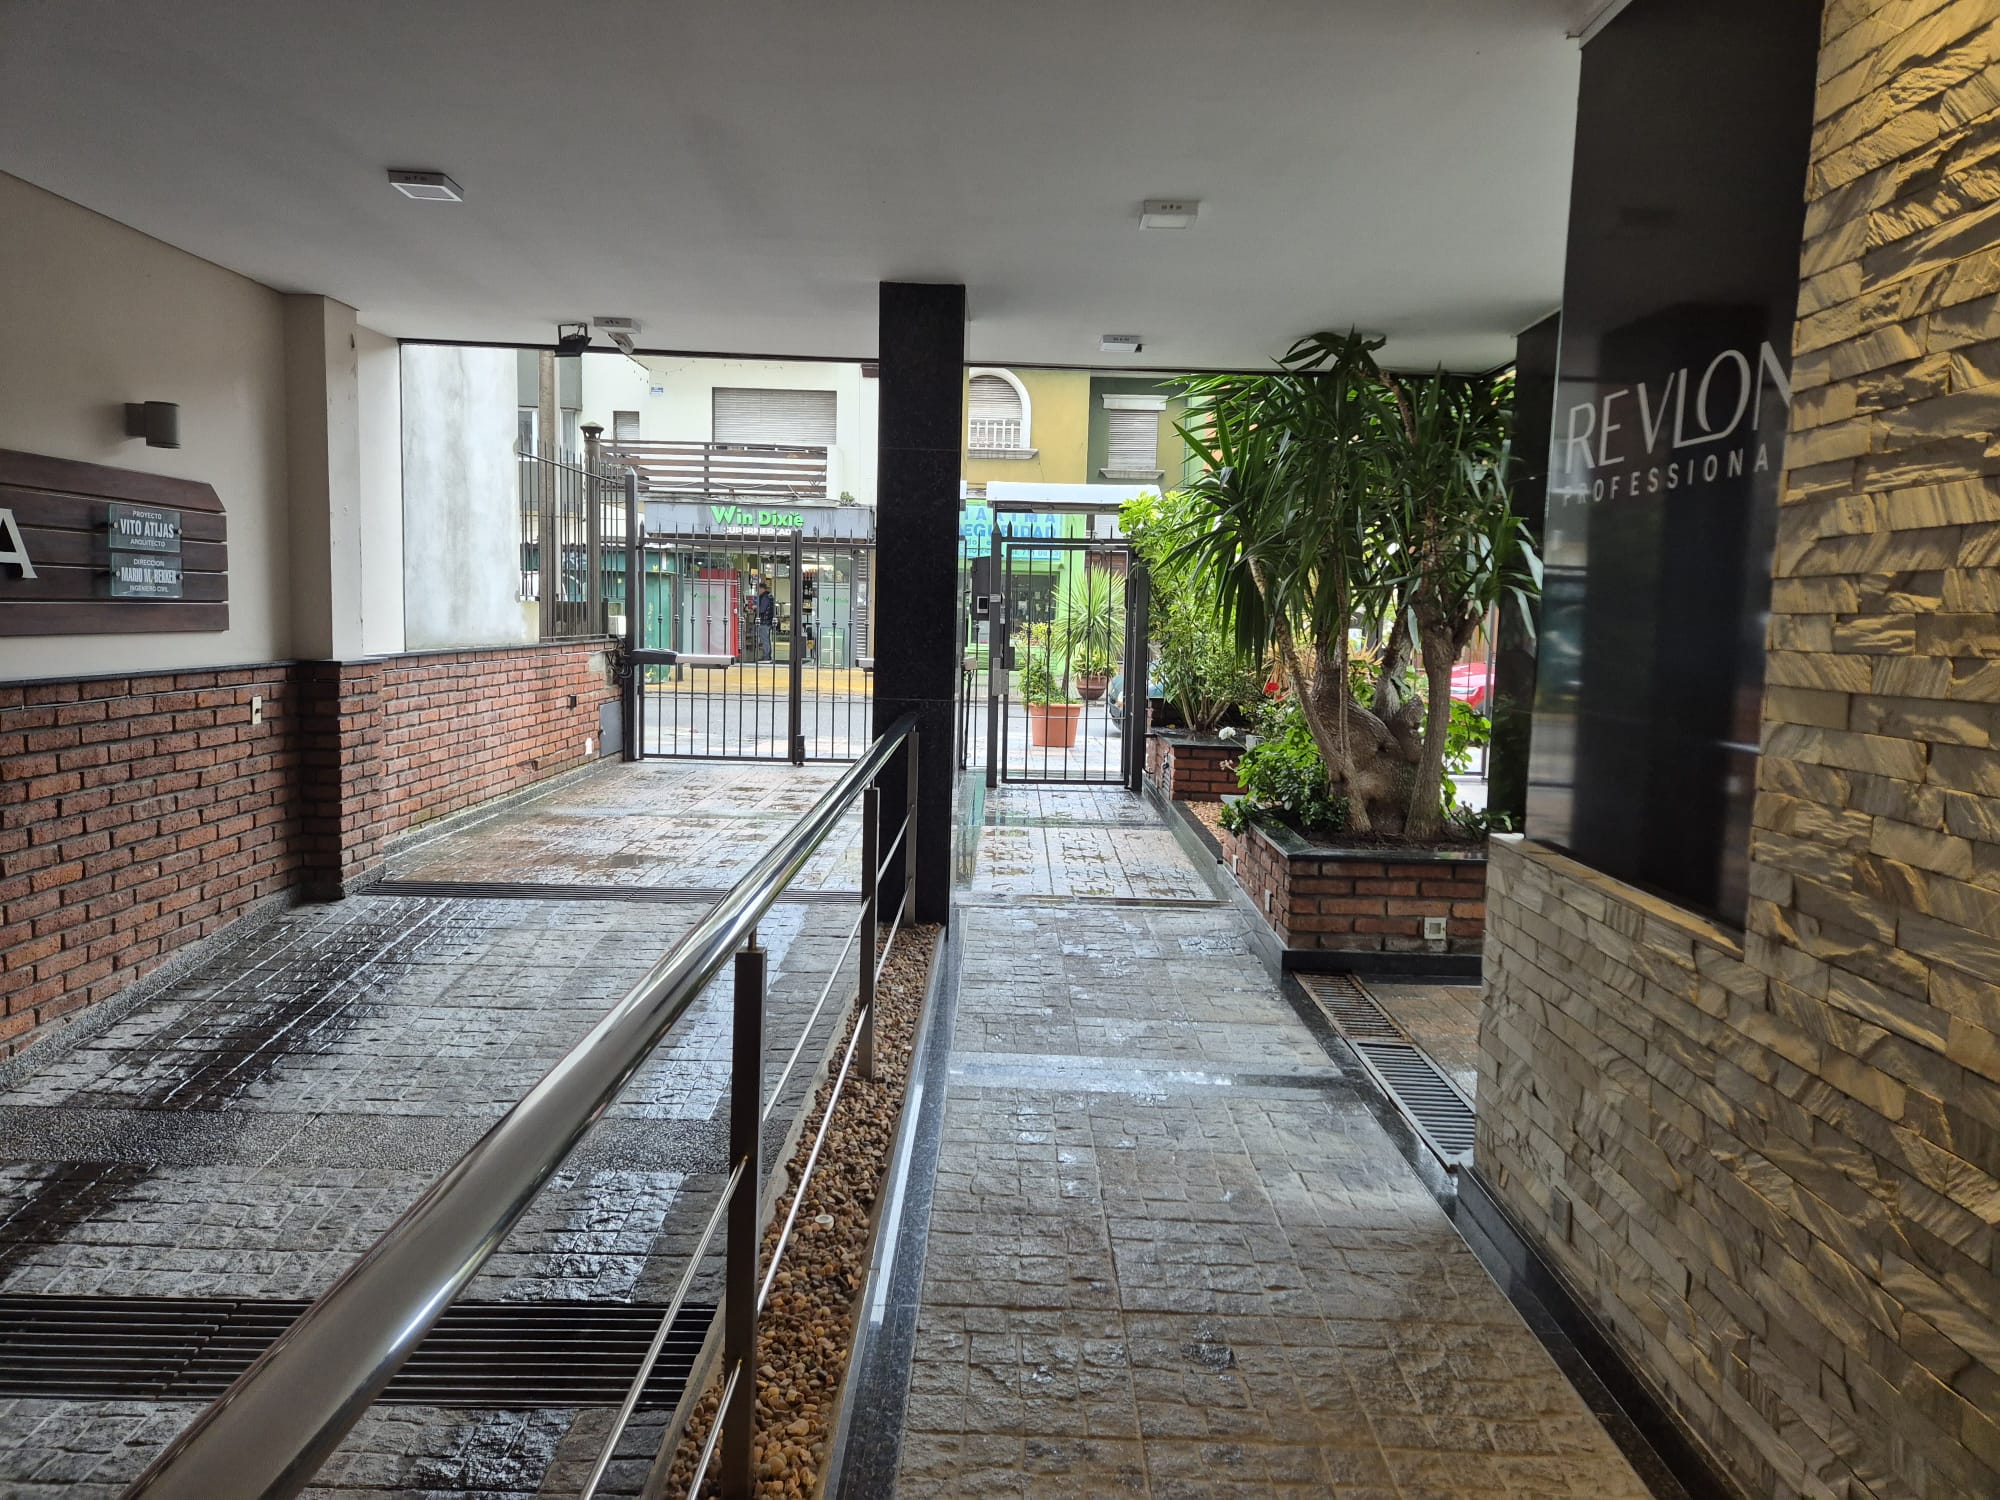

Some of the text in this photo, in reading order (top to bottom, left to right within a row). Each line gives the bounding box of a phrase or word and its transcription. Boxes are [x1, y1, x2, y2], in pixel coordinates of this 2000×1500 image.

[1565, 340, 1794, 474] REVLON
[132, 510, 162, 519] PROYECTO
[710, 505, 805, 527] Win Dixie
[120, 518, 175, 538] VITO ATIJAS
[723, 526, 800, 535] SUPERMERCAD
[130, 538, 166, 547] ARQUITECTO
[121, 566, 143, 582] MARIO
[129, 584, 156, 592] INGENIERO
